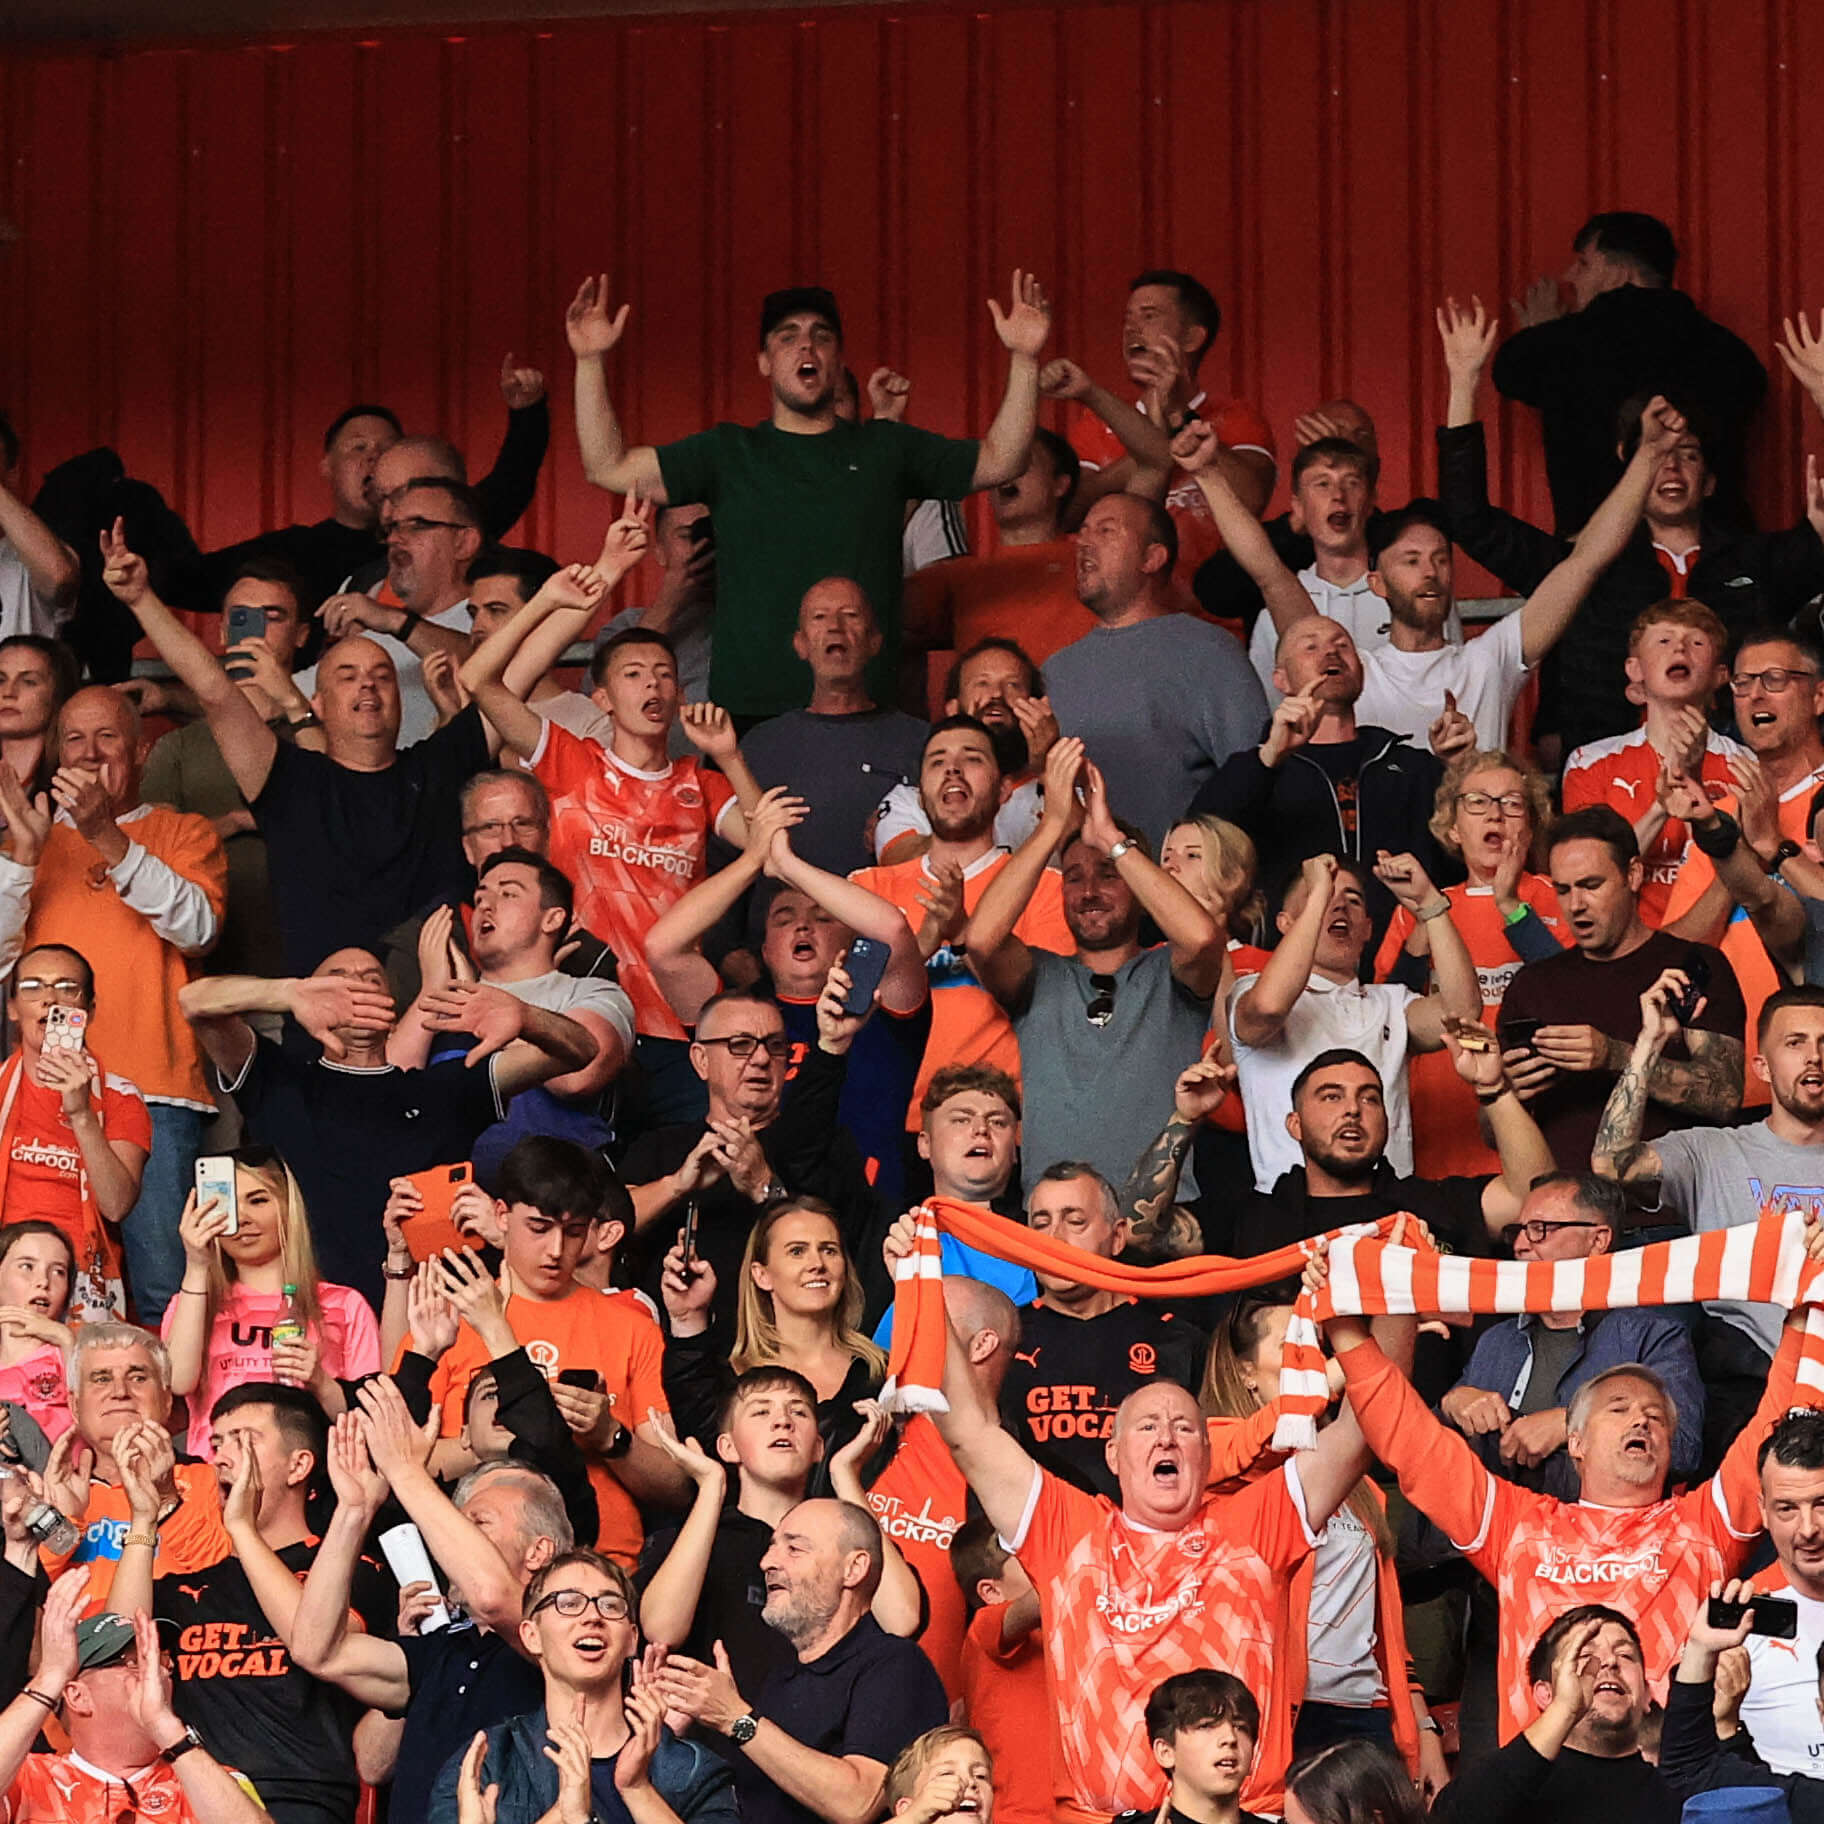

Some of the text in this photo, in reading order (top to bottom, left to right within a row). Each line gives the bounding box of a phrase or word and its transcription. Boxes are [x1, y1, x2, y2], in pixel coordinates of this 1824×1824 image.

[11, 1150, 80, 1173] CKPOOL
[1026, 1385, 1096, 1414] GET
[1028, 1416, 1114, 1442] VOCA
[179, 1622, 248, 1652] GET
[178, 1649, 288, 1679] VOCAL
